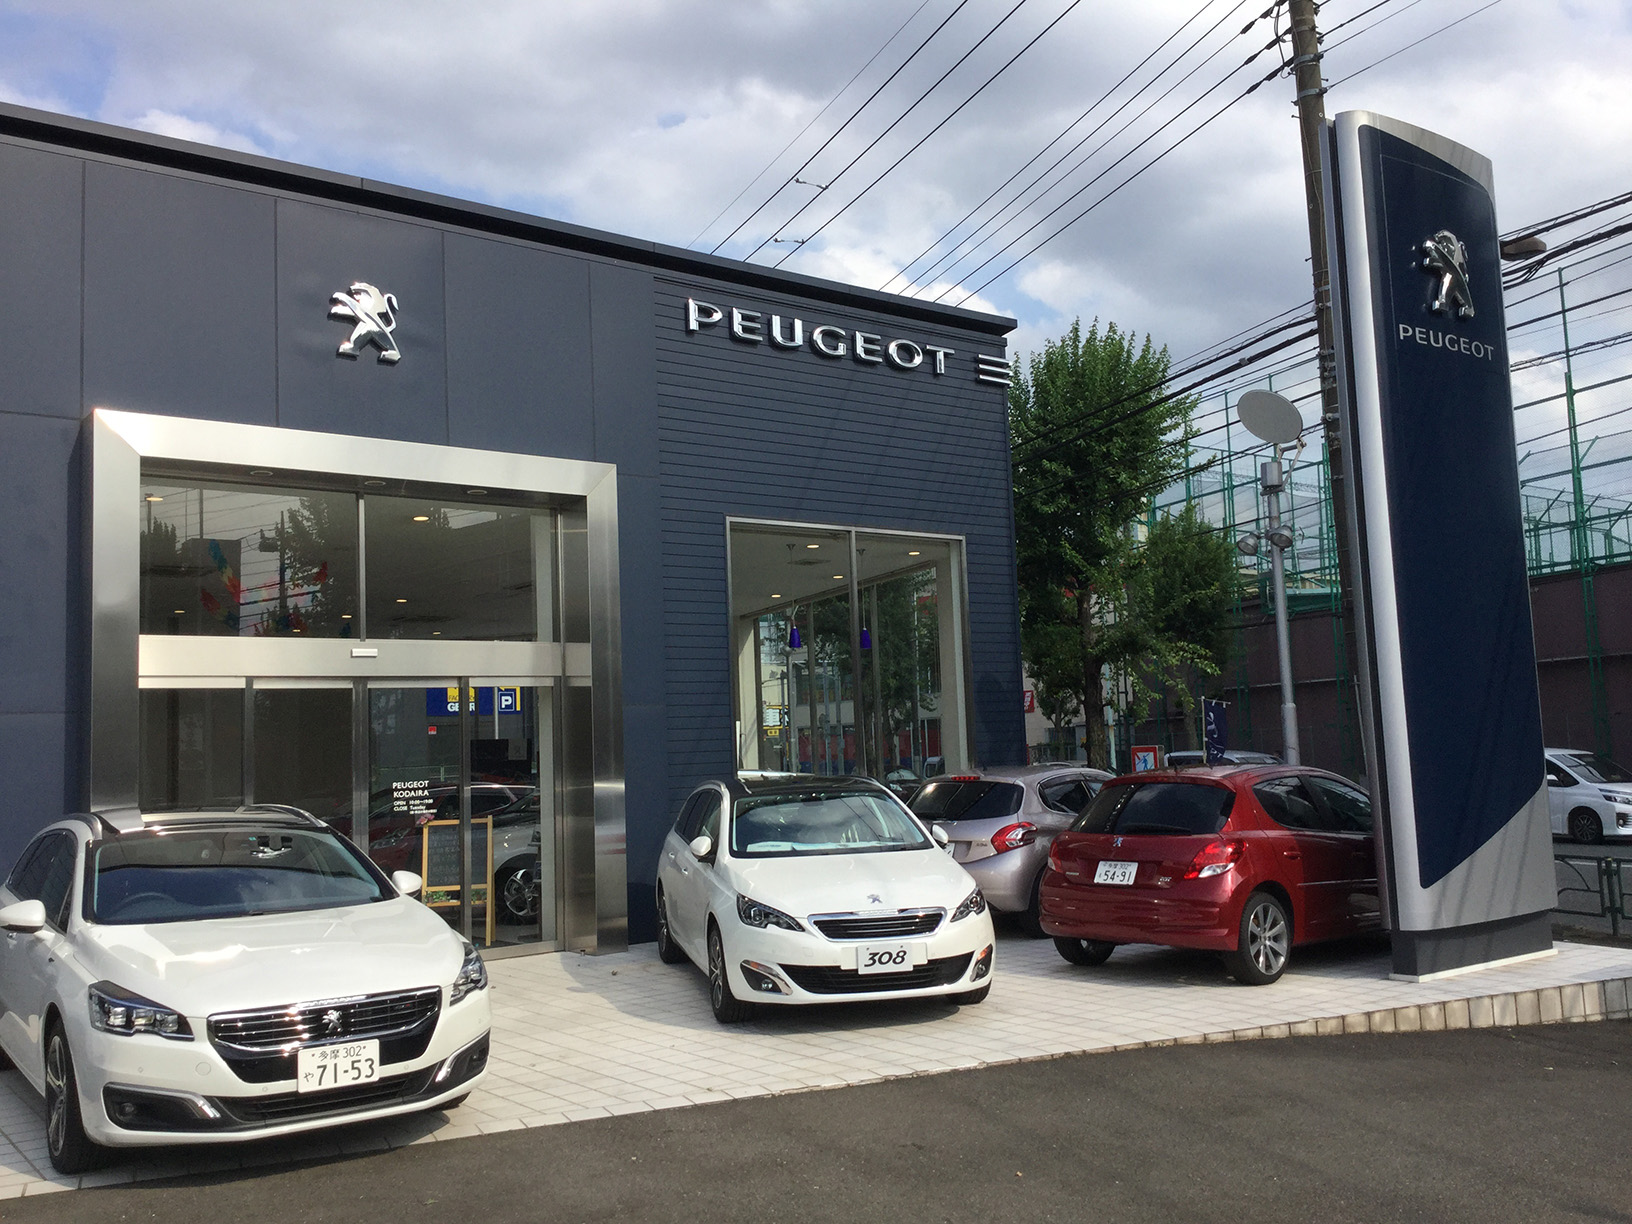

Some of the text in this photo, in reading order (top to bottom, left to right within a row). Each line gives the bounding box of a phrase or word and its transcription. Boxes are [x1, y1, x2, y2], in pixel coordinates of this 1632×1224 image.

[687, 298, 955, 374] PEUGEOT
[1399, 324, 1494, 361] PEUGEOT
[447, 702, 475, 712] GER
[501, 696, 512, 708] P
[392, 781, 430, 789] PEUGEOT
[393, 790, 430, 798] KODAIRA
[1103, 870, 1132, 882] 54-91
[864, 950, 907, 967] 308
[319, 1045, 362, 1062] 多摩 302
[303, 1058, 375, 1086] や 71-53
